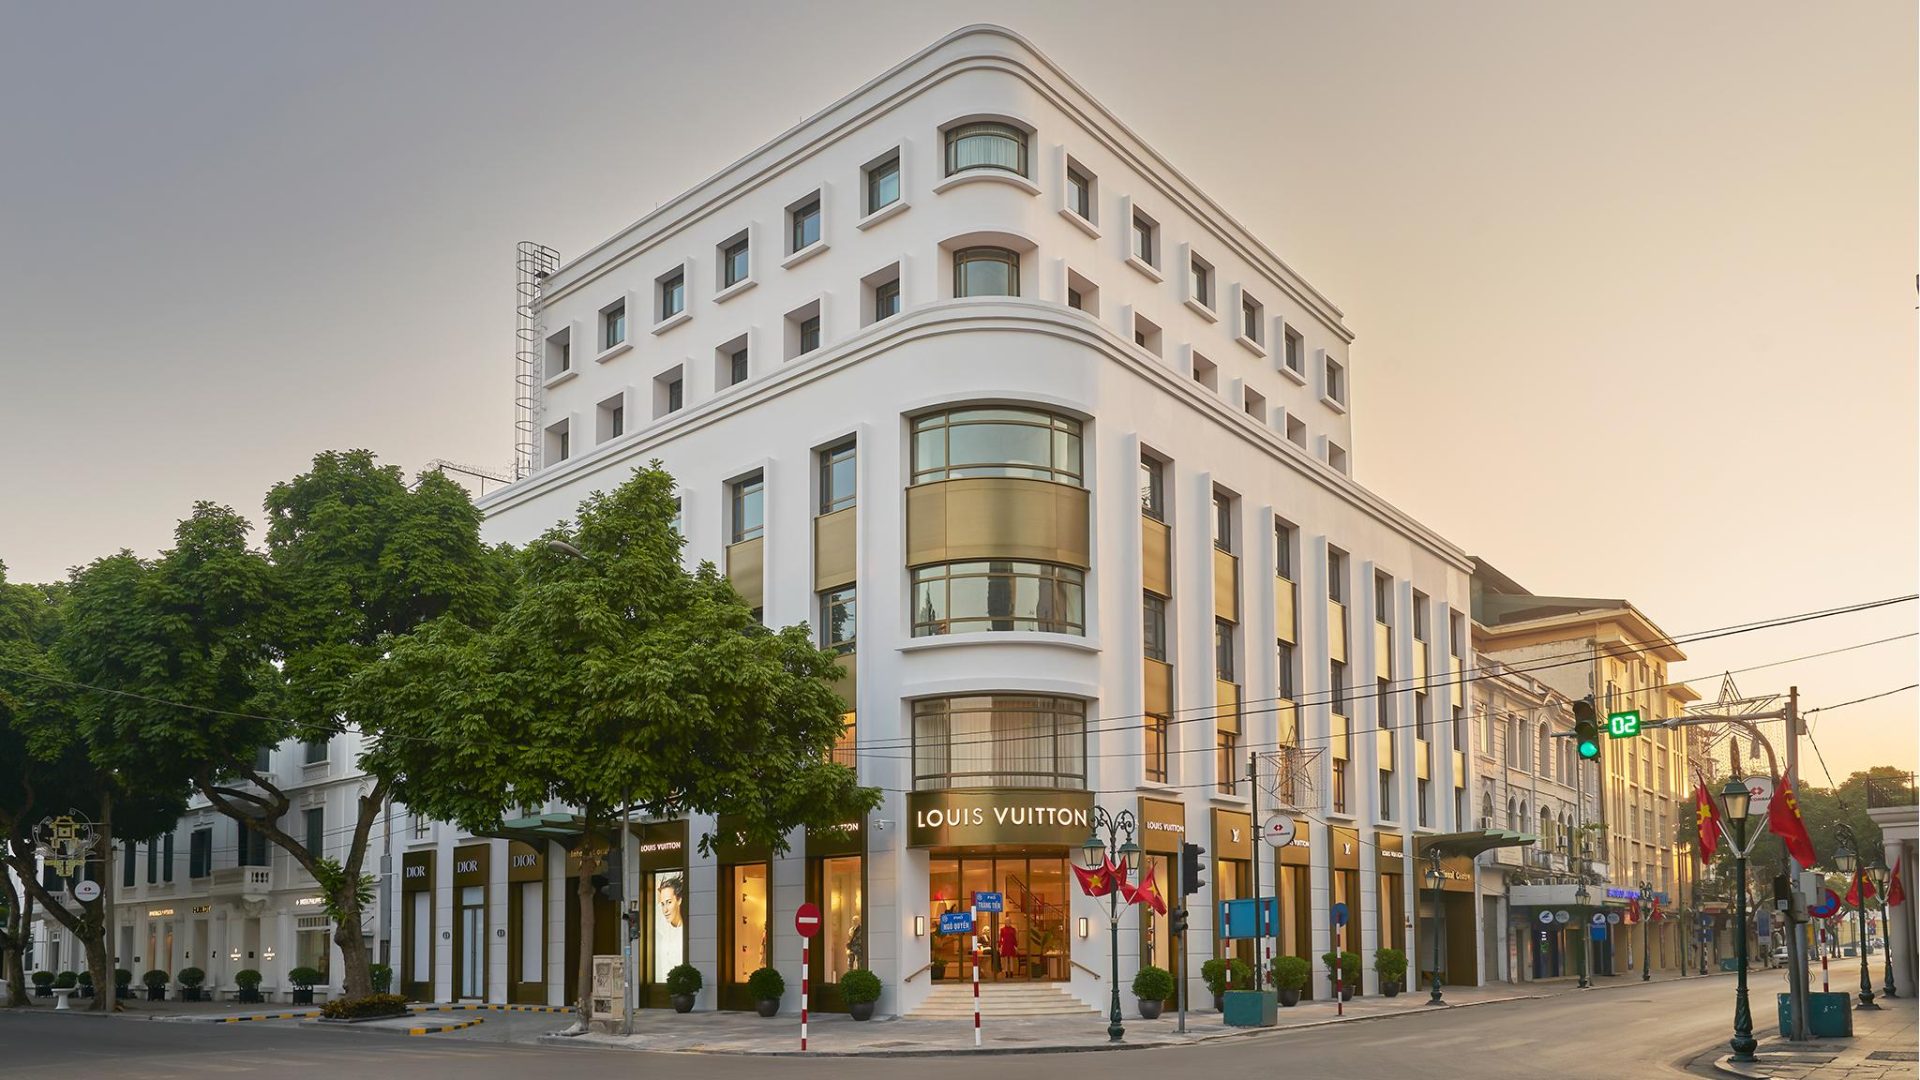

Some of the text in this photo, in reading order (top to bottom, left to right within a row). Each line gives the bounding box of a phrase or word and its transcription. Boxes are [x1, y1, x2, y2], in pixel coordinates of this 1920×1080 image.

[1611, 715, 1637, 735] 02
[917, 807, 1088, 828] LOUIS VUITTON
[1146, 821, 1185, 833] LOUIS VUITTON
[640, 841, 681, 853] LOUIS VUITTON
[457, 860, 479, 873] DIOR
[513, 854, 537, 868] DIOR
[406, 866, 426, 878] DIOR
